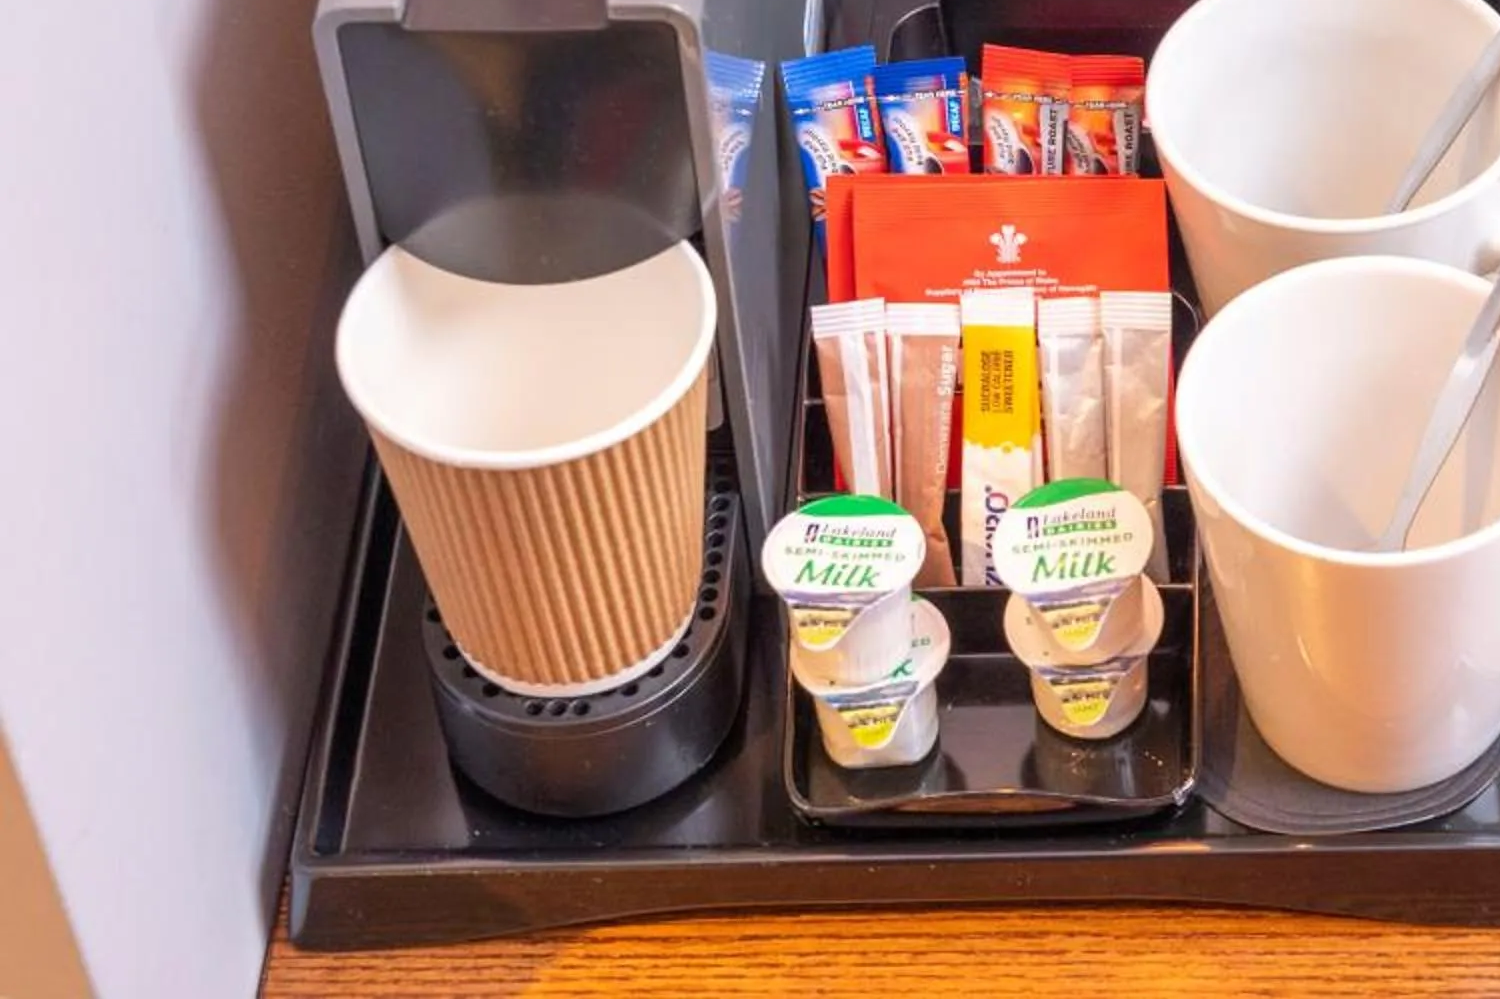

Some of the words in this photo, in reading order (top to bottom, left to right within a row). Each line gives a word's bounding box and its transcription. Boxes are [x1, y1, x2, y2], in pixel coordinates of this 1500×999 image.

[937, 344, 956, 396] Sugar
[821, 523, 897, 539] Lakeland
[1043, 507, 1117, 526] Lakeland
[794, 558, 881, 588] Milk
[1031, 550, 1117, 583] Milk
